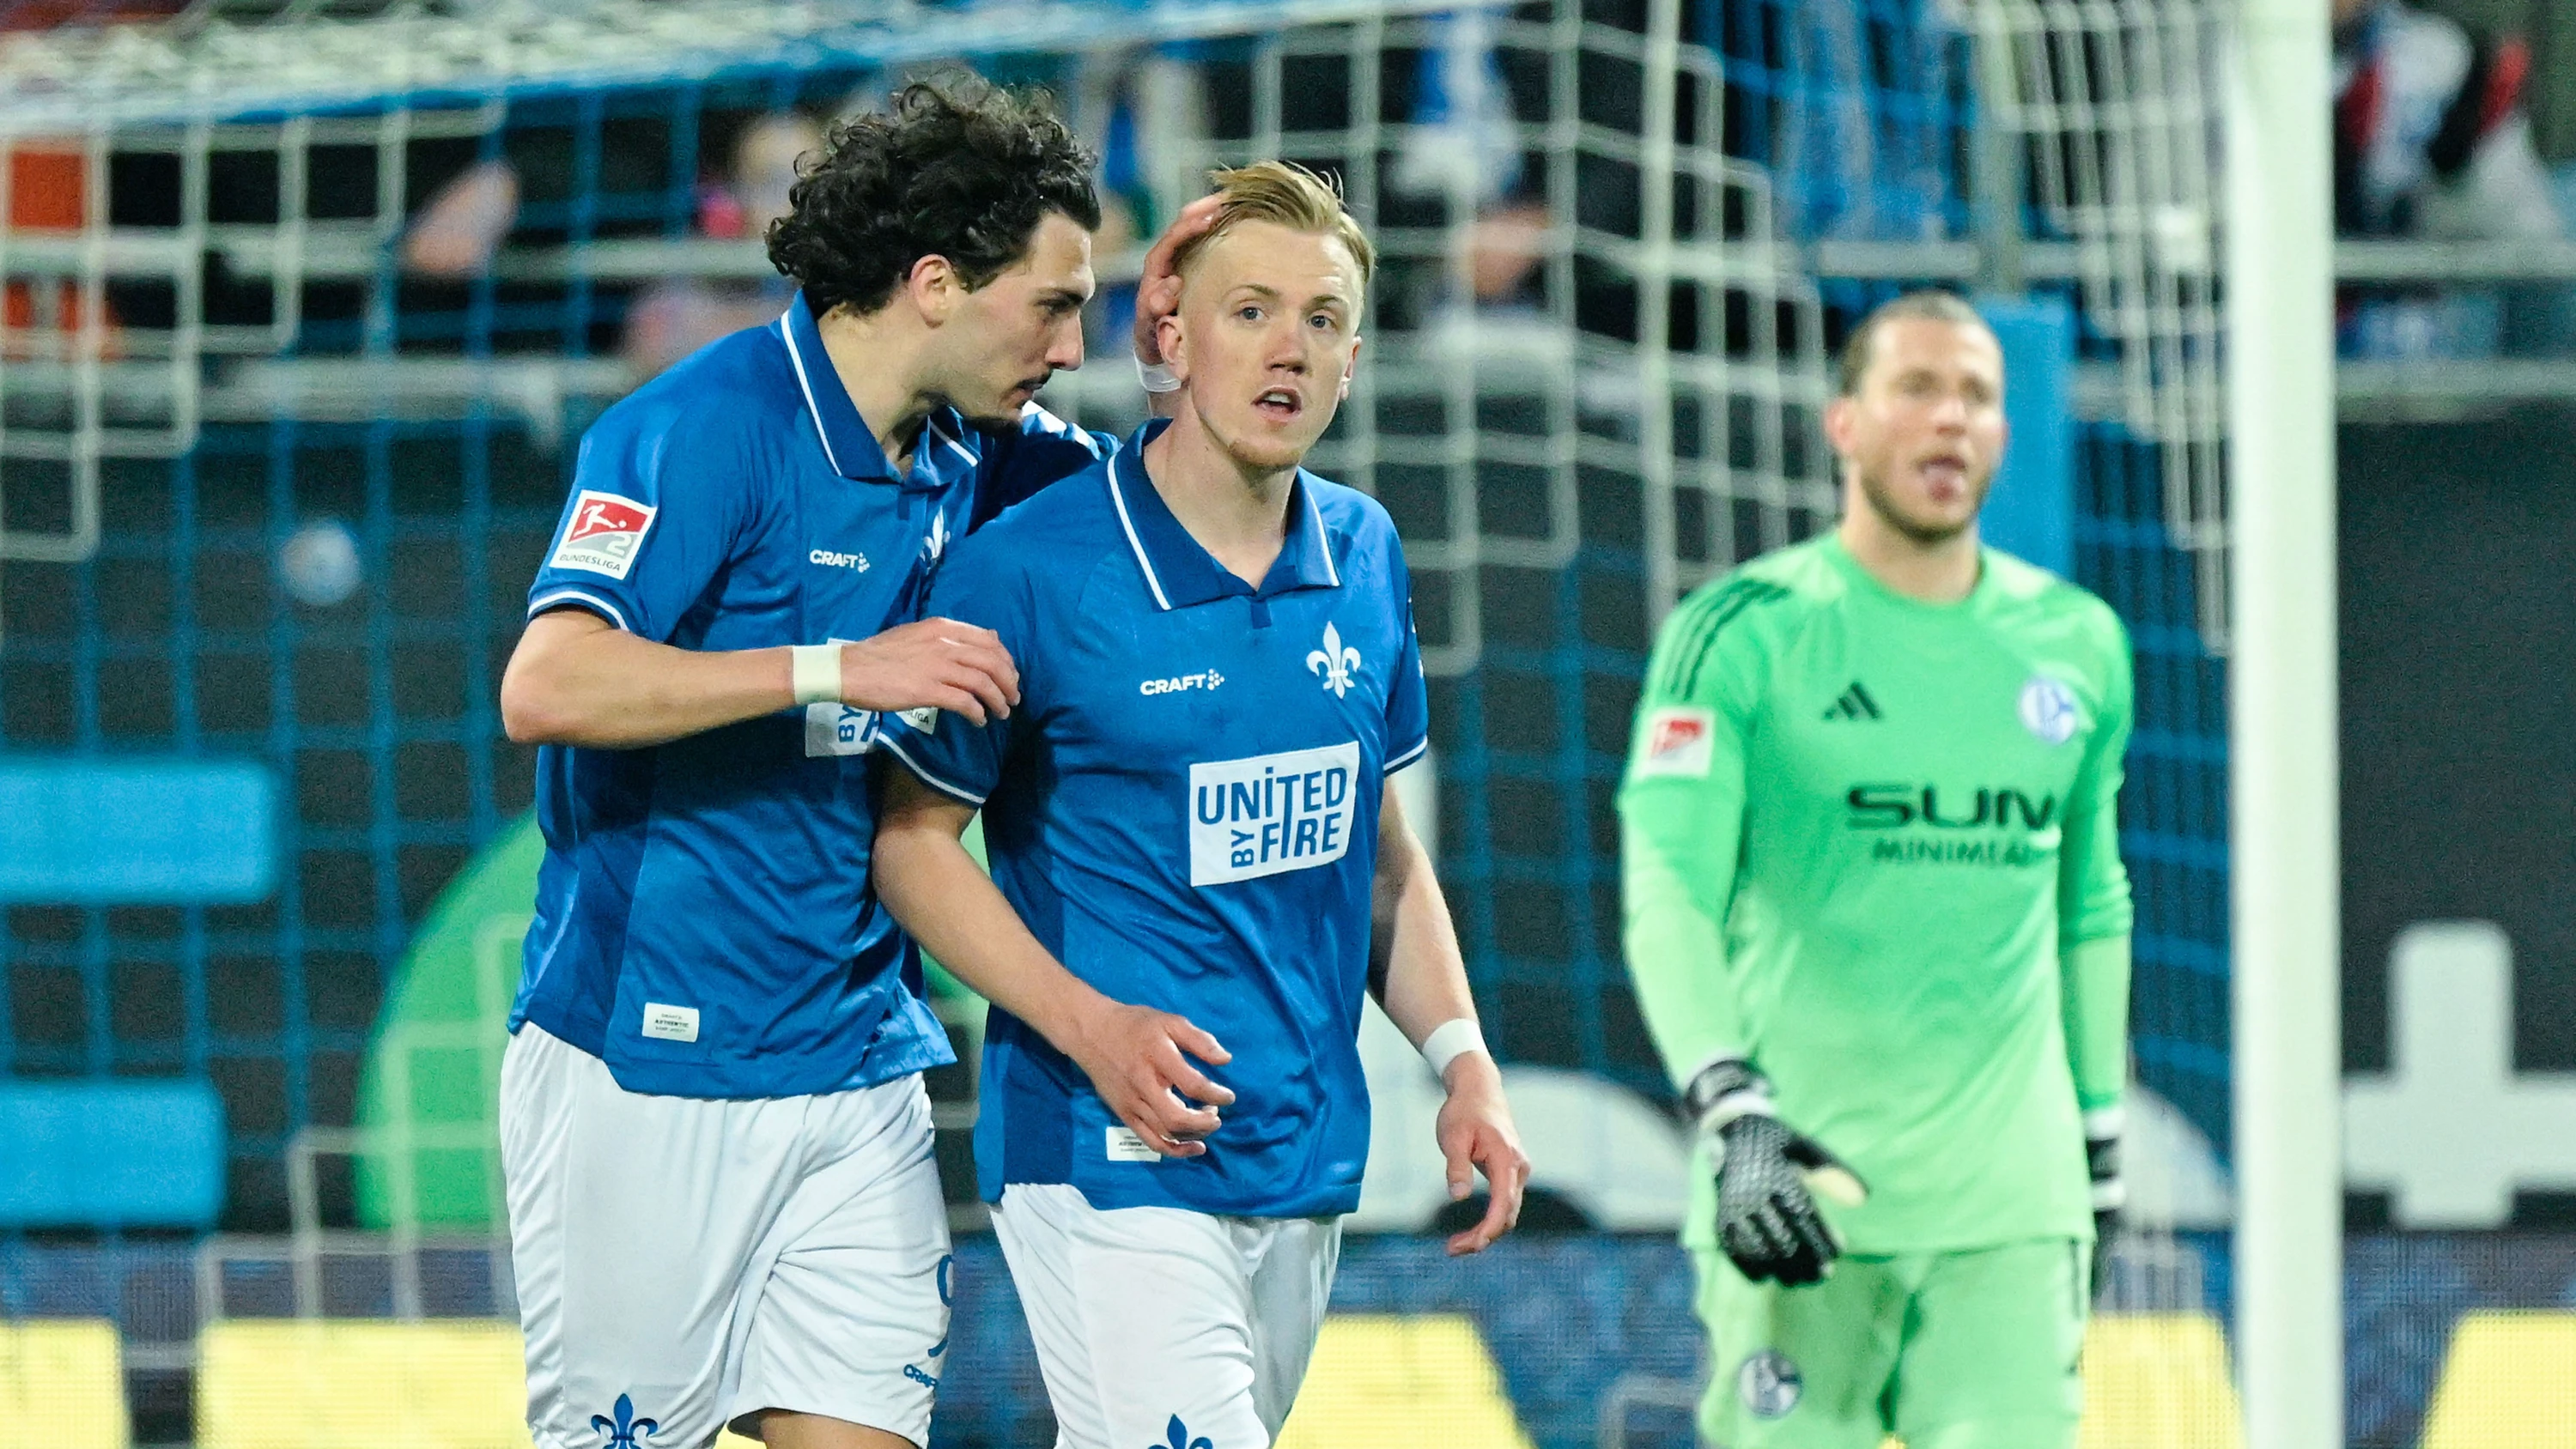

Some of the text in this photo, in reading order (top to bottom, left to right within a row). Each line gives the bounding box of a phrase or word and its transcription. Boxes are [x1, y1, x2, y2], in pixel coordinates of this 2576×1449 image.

[559, 554, 621, 572] BUNDESLIGA
[810, 549, 859, 569] CRAFT
[1140, 674, 1206, 695] CRAFT
[1847, 785, 2056, 831] SUN
[1231, 812, 1342, 869] BY FIRE
